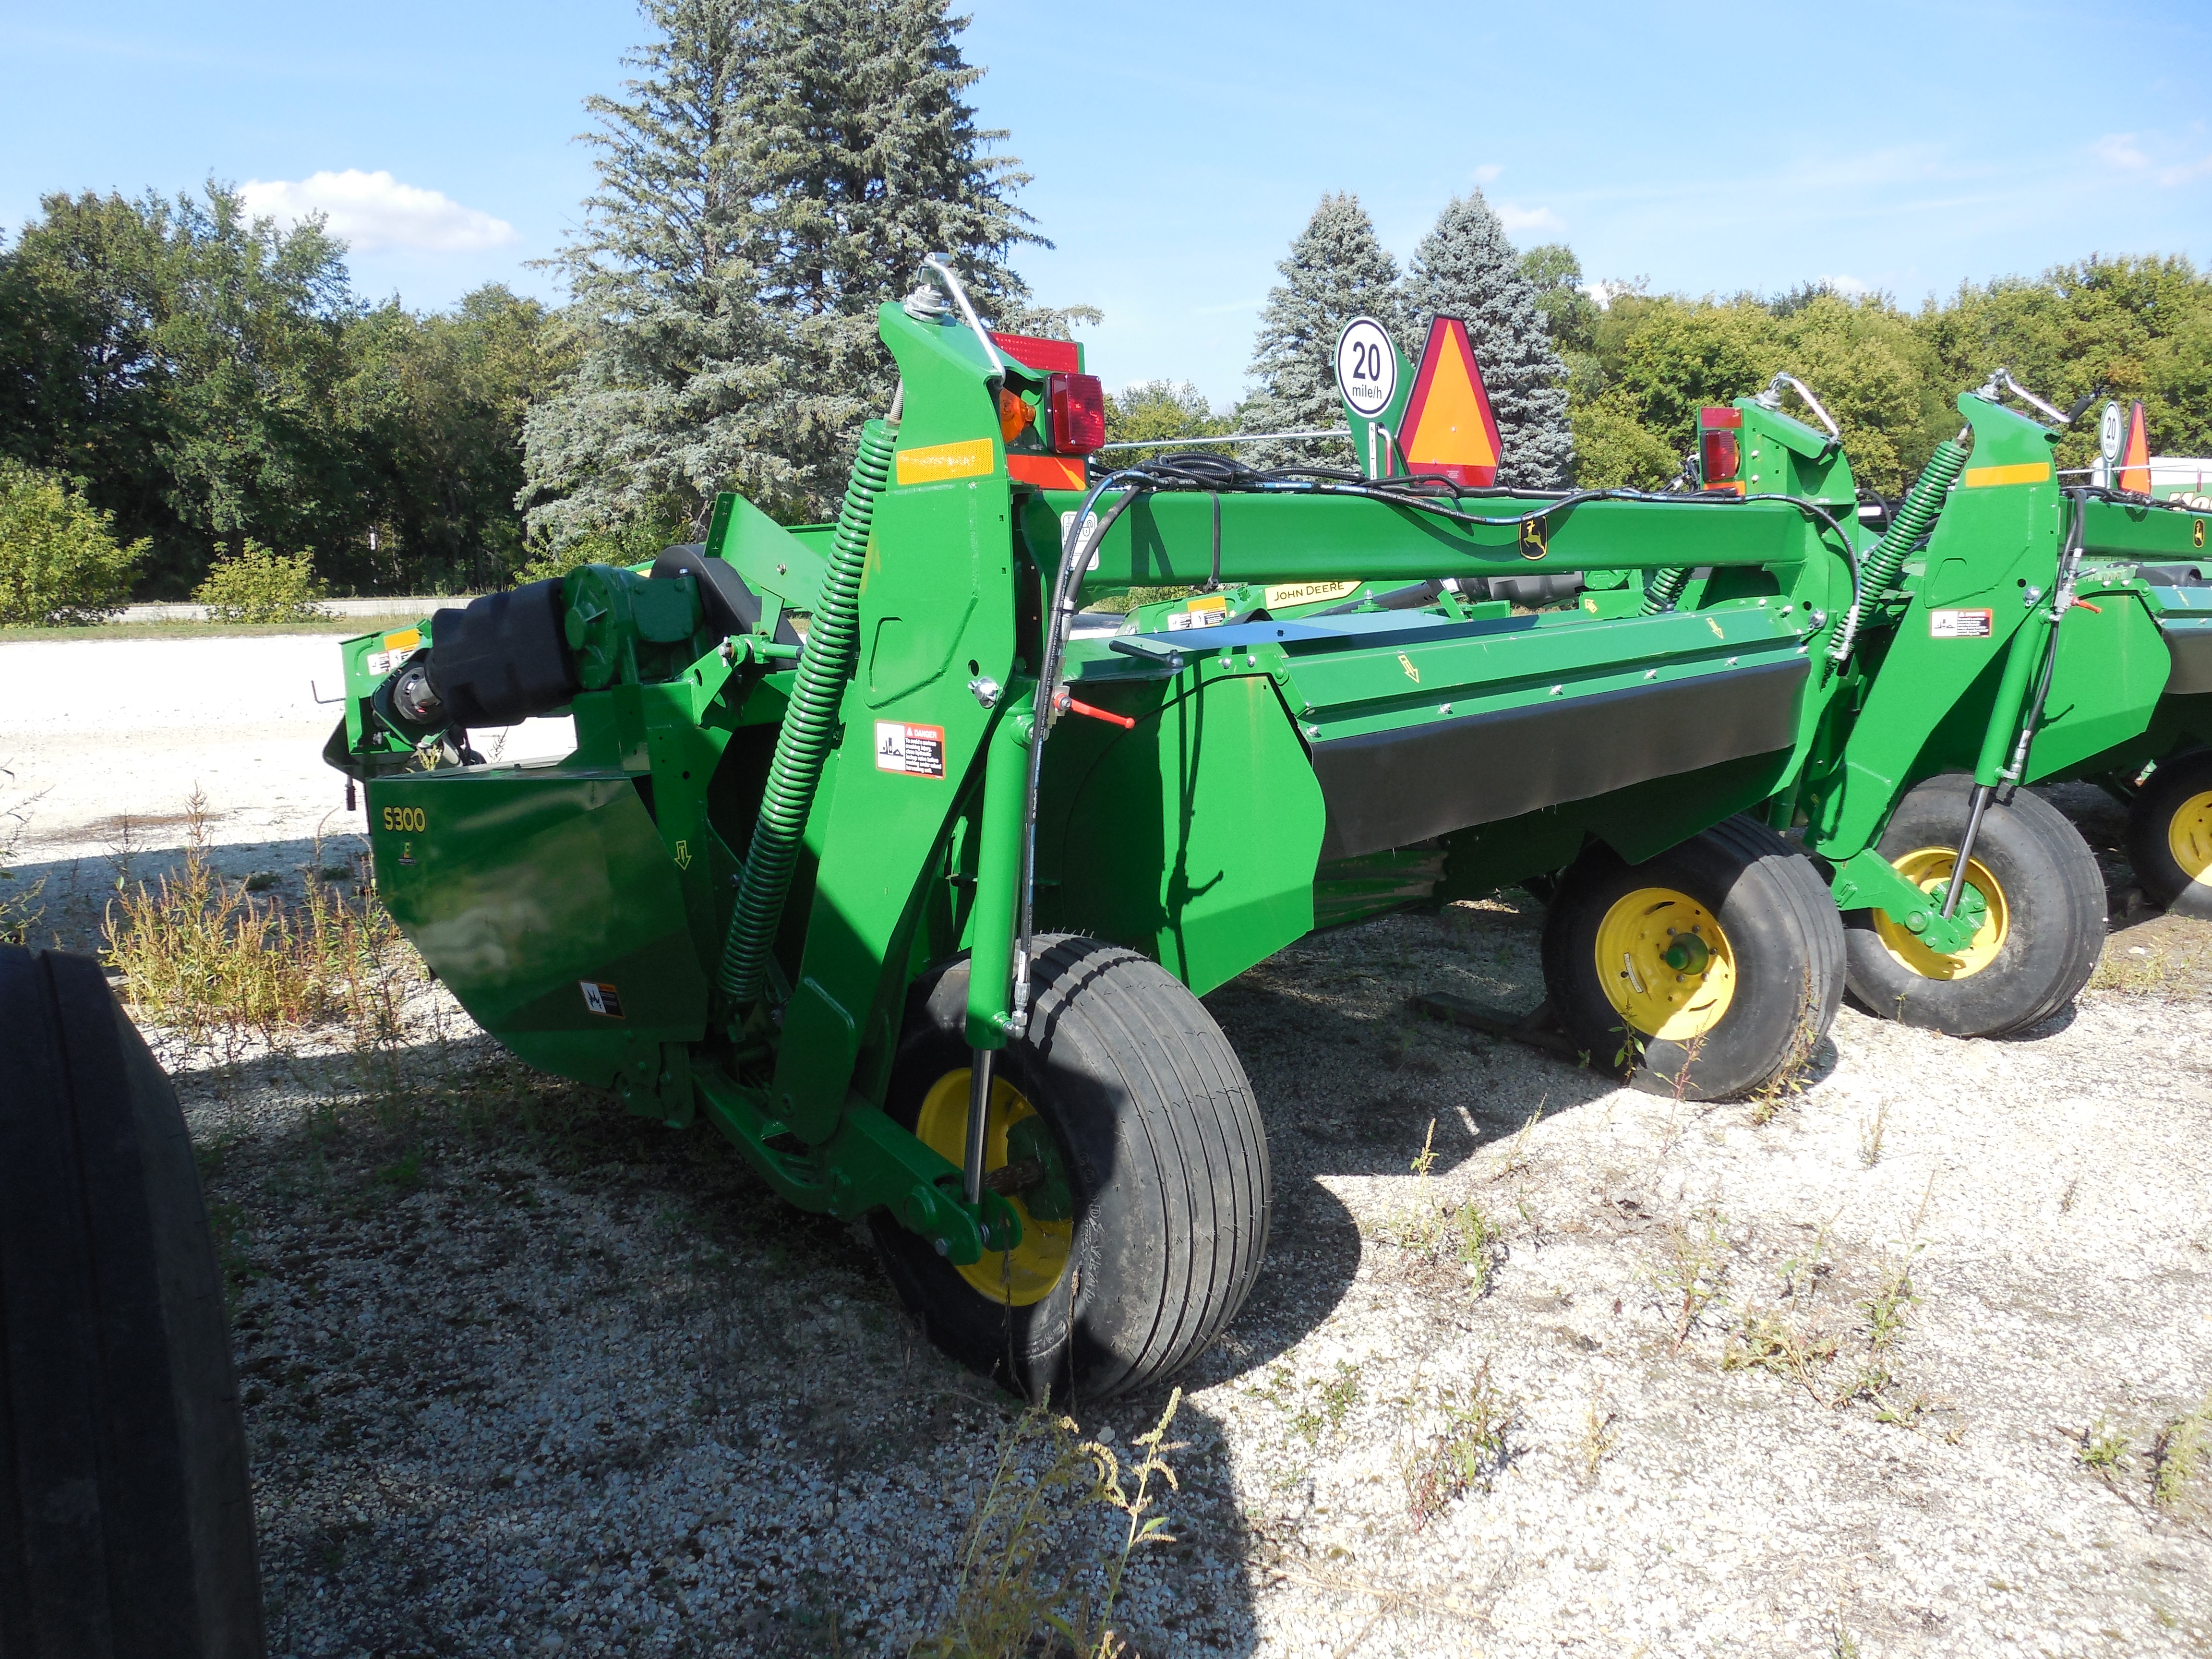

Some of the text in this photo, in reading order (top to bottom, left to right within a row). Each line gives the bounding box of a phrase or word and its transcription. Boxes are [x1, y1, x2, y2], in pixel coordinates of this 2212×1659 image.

[1353, 341, 1381, 381] 20
[1352, 384, 1382, 399] mile/h
[2106, 416, 2116, 440] 20
[1274, 581, 1345, 601] JOHN DEERE
[914, 729, 937, 739] DANGER
[383, 806, 426, 832] S300
